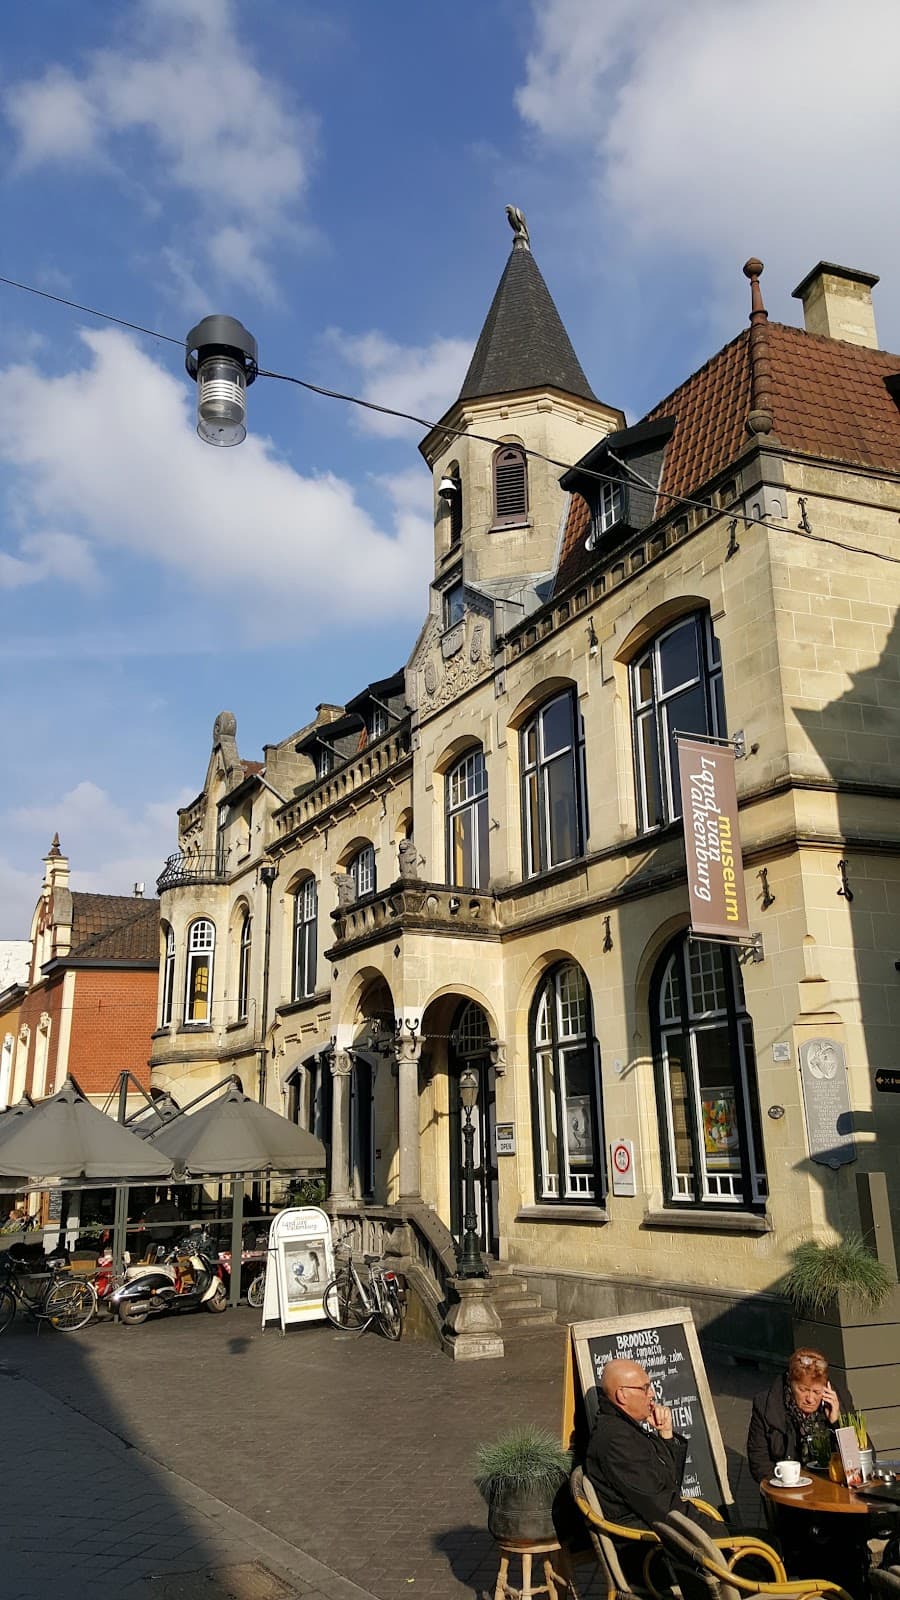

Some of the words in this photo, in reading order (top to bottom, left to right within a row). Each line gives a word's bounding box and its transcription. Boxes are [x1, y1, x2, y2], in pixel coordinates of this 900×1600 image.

[701, 756, 721, 815] Land
[689, 774, 711, 902] Valkenburg
[706, 819, 721, 862] van
[718, 816, 739, 921] museum
[616, 1330, 659, 1349] BROODJES
